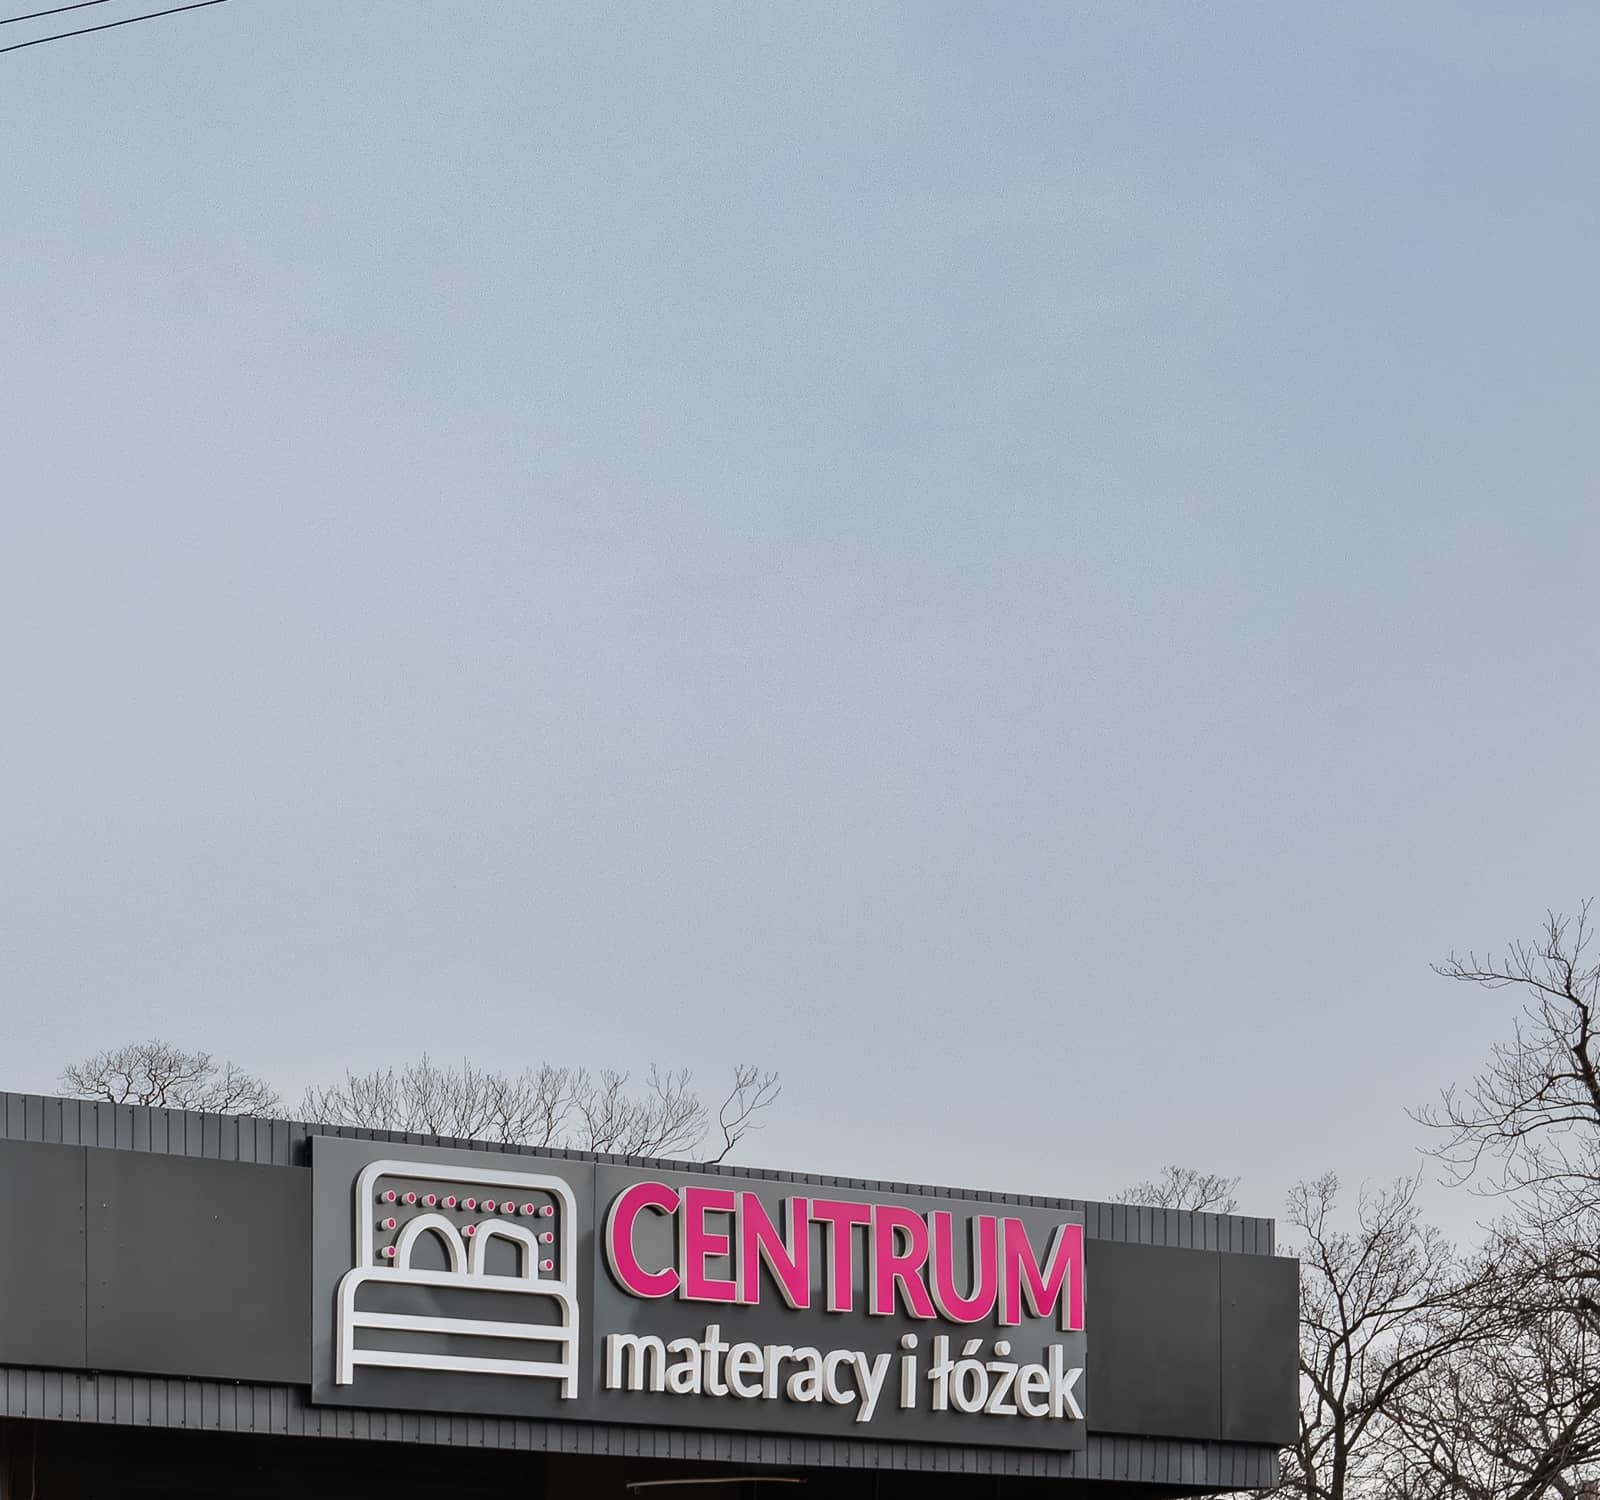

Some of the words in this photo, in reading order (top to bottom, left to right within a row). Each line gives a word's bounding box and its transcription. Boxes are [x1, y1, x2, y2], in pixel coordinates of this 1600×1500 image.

[605, 1181, 1086, 1331] CENTRUM
[606, 1324, 892, 1423] materacy
[900, 1333, 918, 1409] i
[928, 1334, 1085, 1420] łóżek
